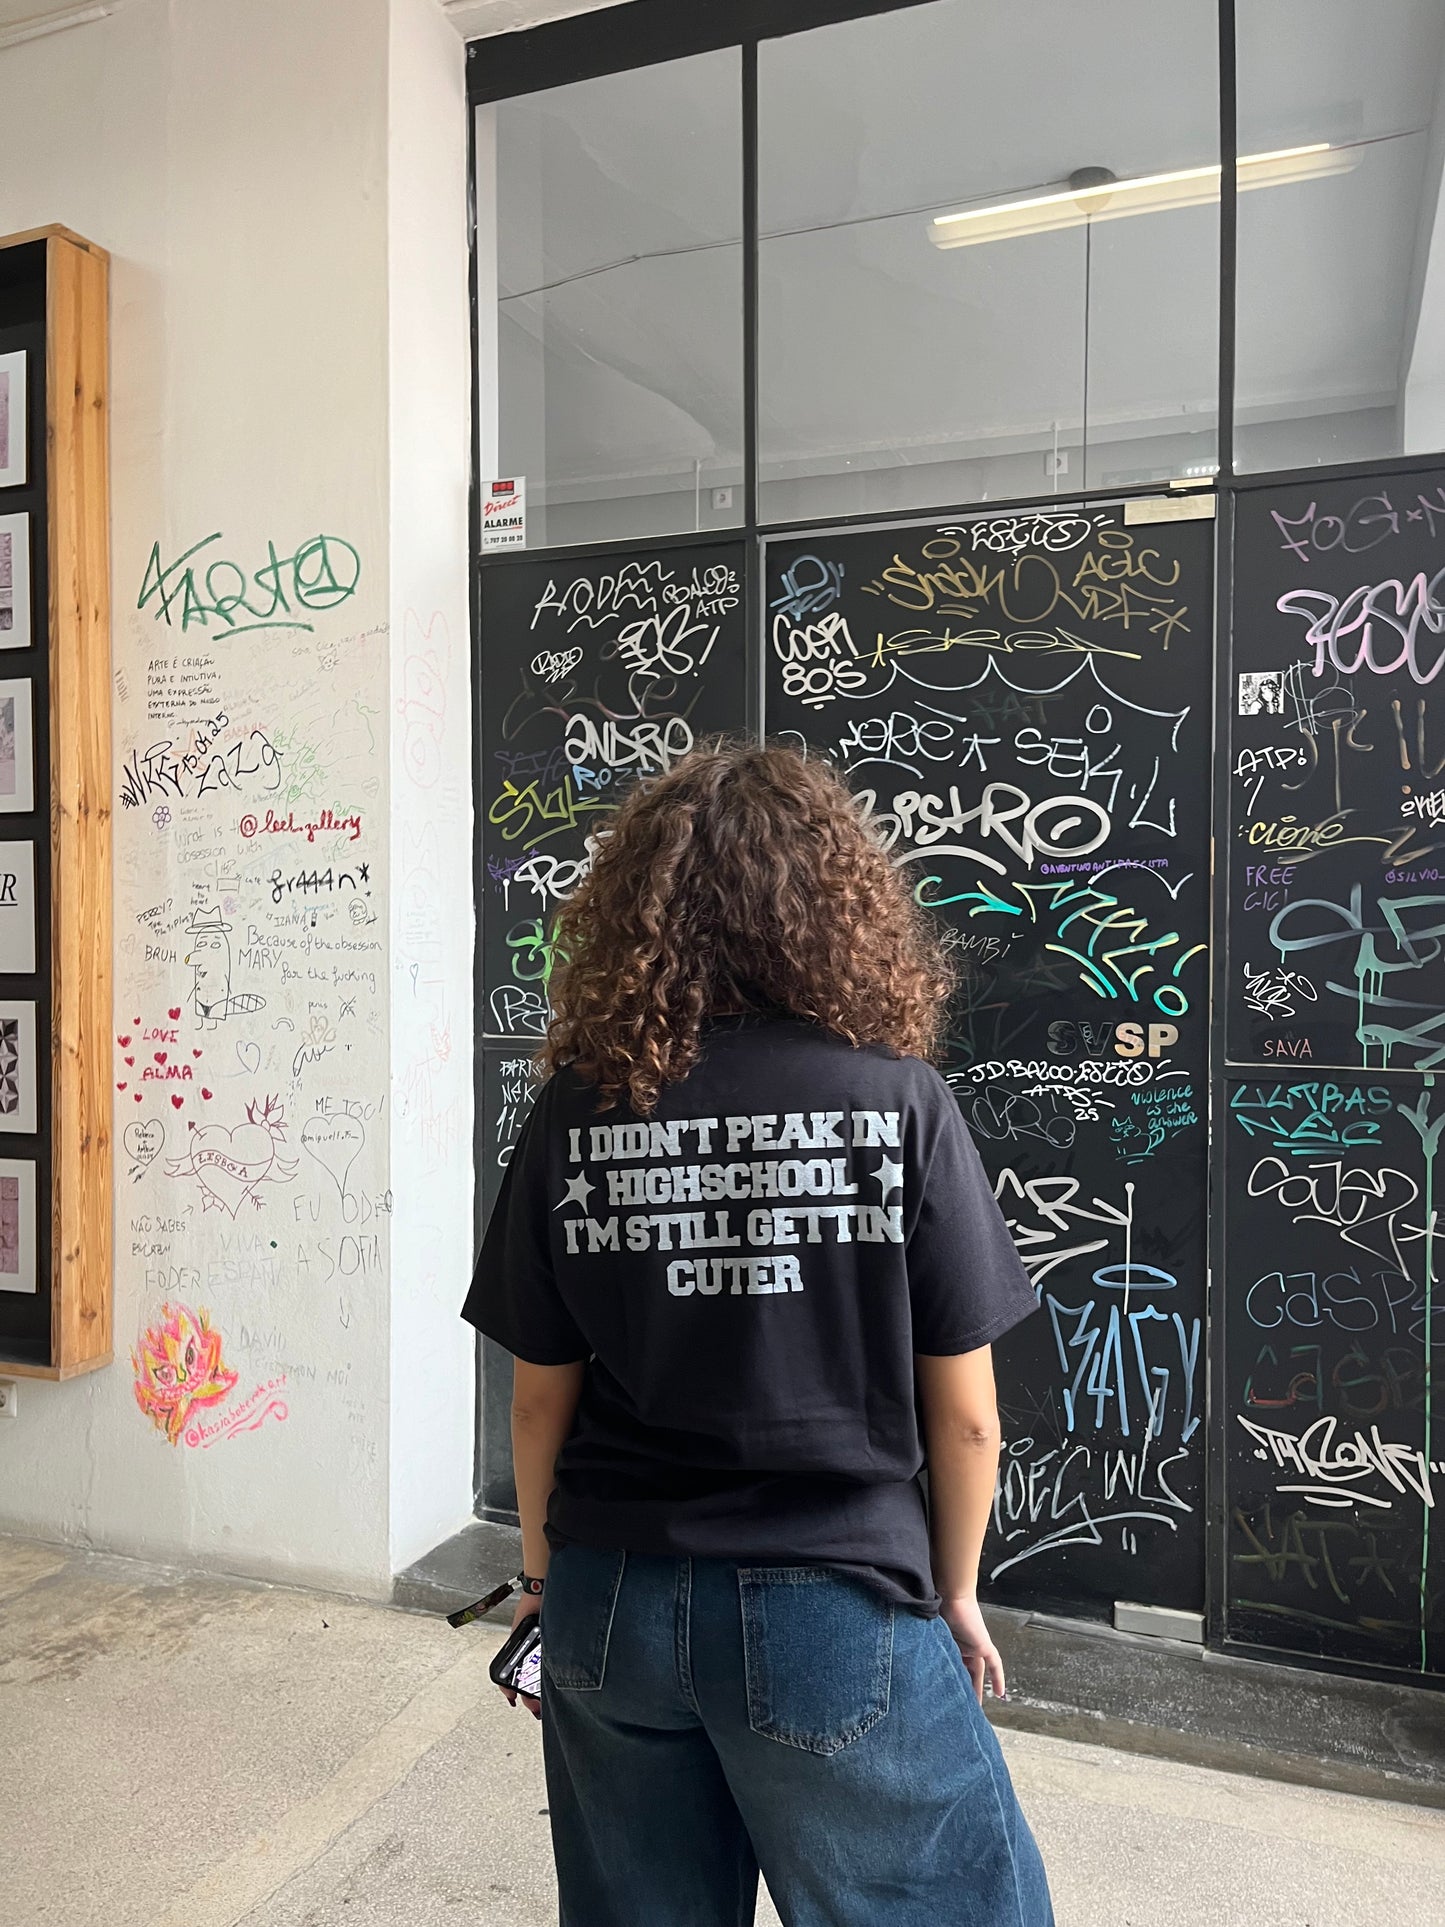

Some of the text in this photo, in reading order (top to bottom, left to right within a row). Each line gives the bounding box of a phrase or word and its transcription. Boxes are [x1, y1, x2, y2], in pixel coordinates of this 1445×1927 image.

[484, 517, 523, 528] ALARME
[147, 674, 166, 685] PURA
[1246, 865, 1297, 887] FREE
[247, 926, 382, 956] Because of the obsession
[145, 944, 177, 963] BRUH
[238, 948, 282, 969] MARY
[281, 962, 376, 993] for the fucking
[1263, 1039, 1313, 1058] SAVA
[142, 1066, 193, 1081] ALMA
[315, 1095, 333, 1116] ME
[569, 1110, 901, 1163] I DIDN'T PEAK IN
[198, 1152, 249, 1178] LISBOA
[606, 1157, 859, 1206] HIGHSCHOOL
[131, 1215, 186, 1233] NÃO SABES
[564, 1205, 904, 1254] I'M STILL GETTIN
[318, 1235, 383, 1284] SOFIA
[667, 1254, 804, 1297] CUTER
